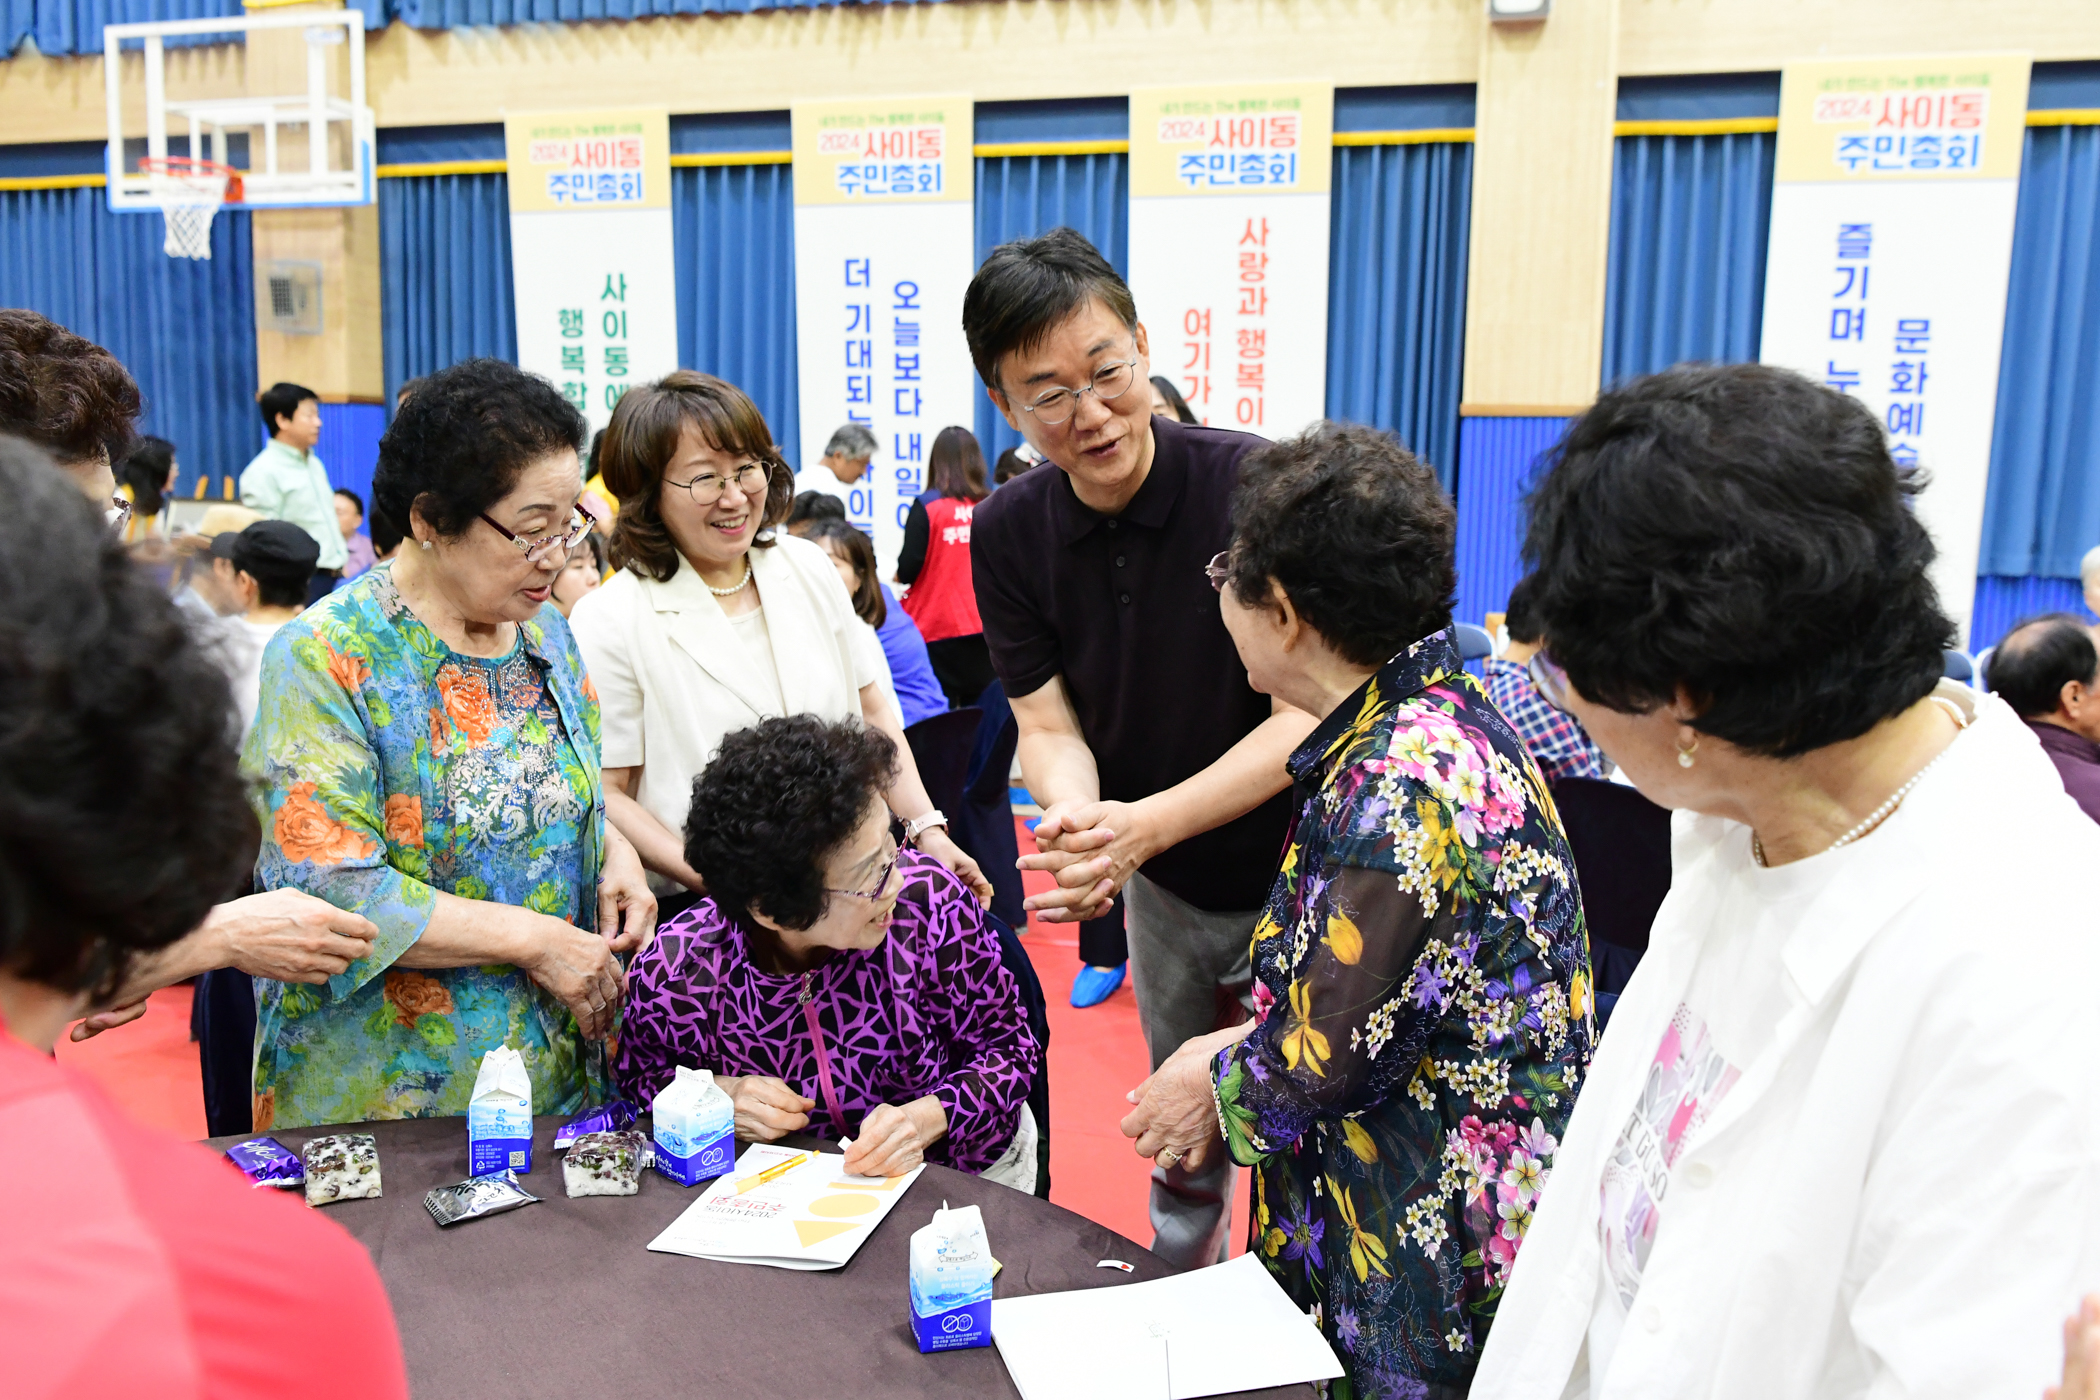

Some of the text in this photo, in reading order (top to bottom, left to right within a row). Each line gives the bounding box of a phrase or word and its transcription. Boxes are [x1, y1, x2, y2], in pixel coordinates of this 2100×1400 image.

[1818, 94, 1983, 128] 2024 사이동
[821, 129, 941, 159] 2024 사이동
[1162, 116, 1296, 148] 2024 사이동
[572, 140, 640, 168] 사이동
[1839, 134, 1979, 170] 주민총회
[839, 163, 941, 194] 주민총회
[1181, 153, 1296, 186] 주민총회
[550, 172, 642, 203] 주민총회
[845, 258, 870, 288] 더
[1235, 217, 1269, 426] 사랑과 행복이
[1825, 223, 1873, 393] 즐기며 누
[893, 280, 923, 417] 오늘보다
[1183, 307, 1212, 404] 여기가
[942, 525, 971, 545] 주민
